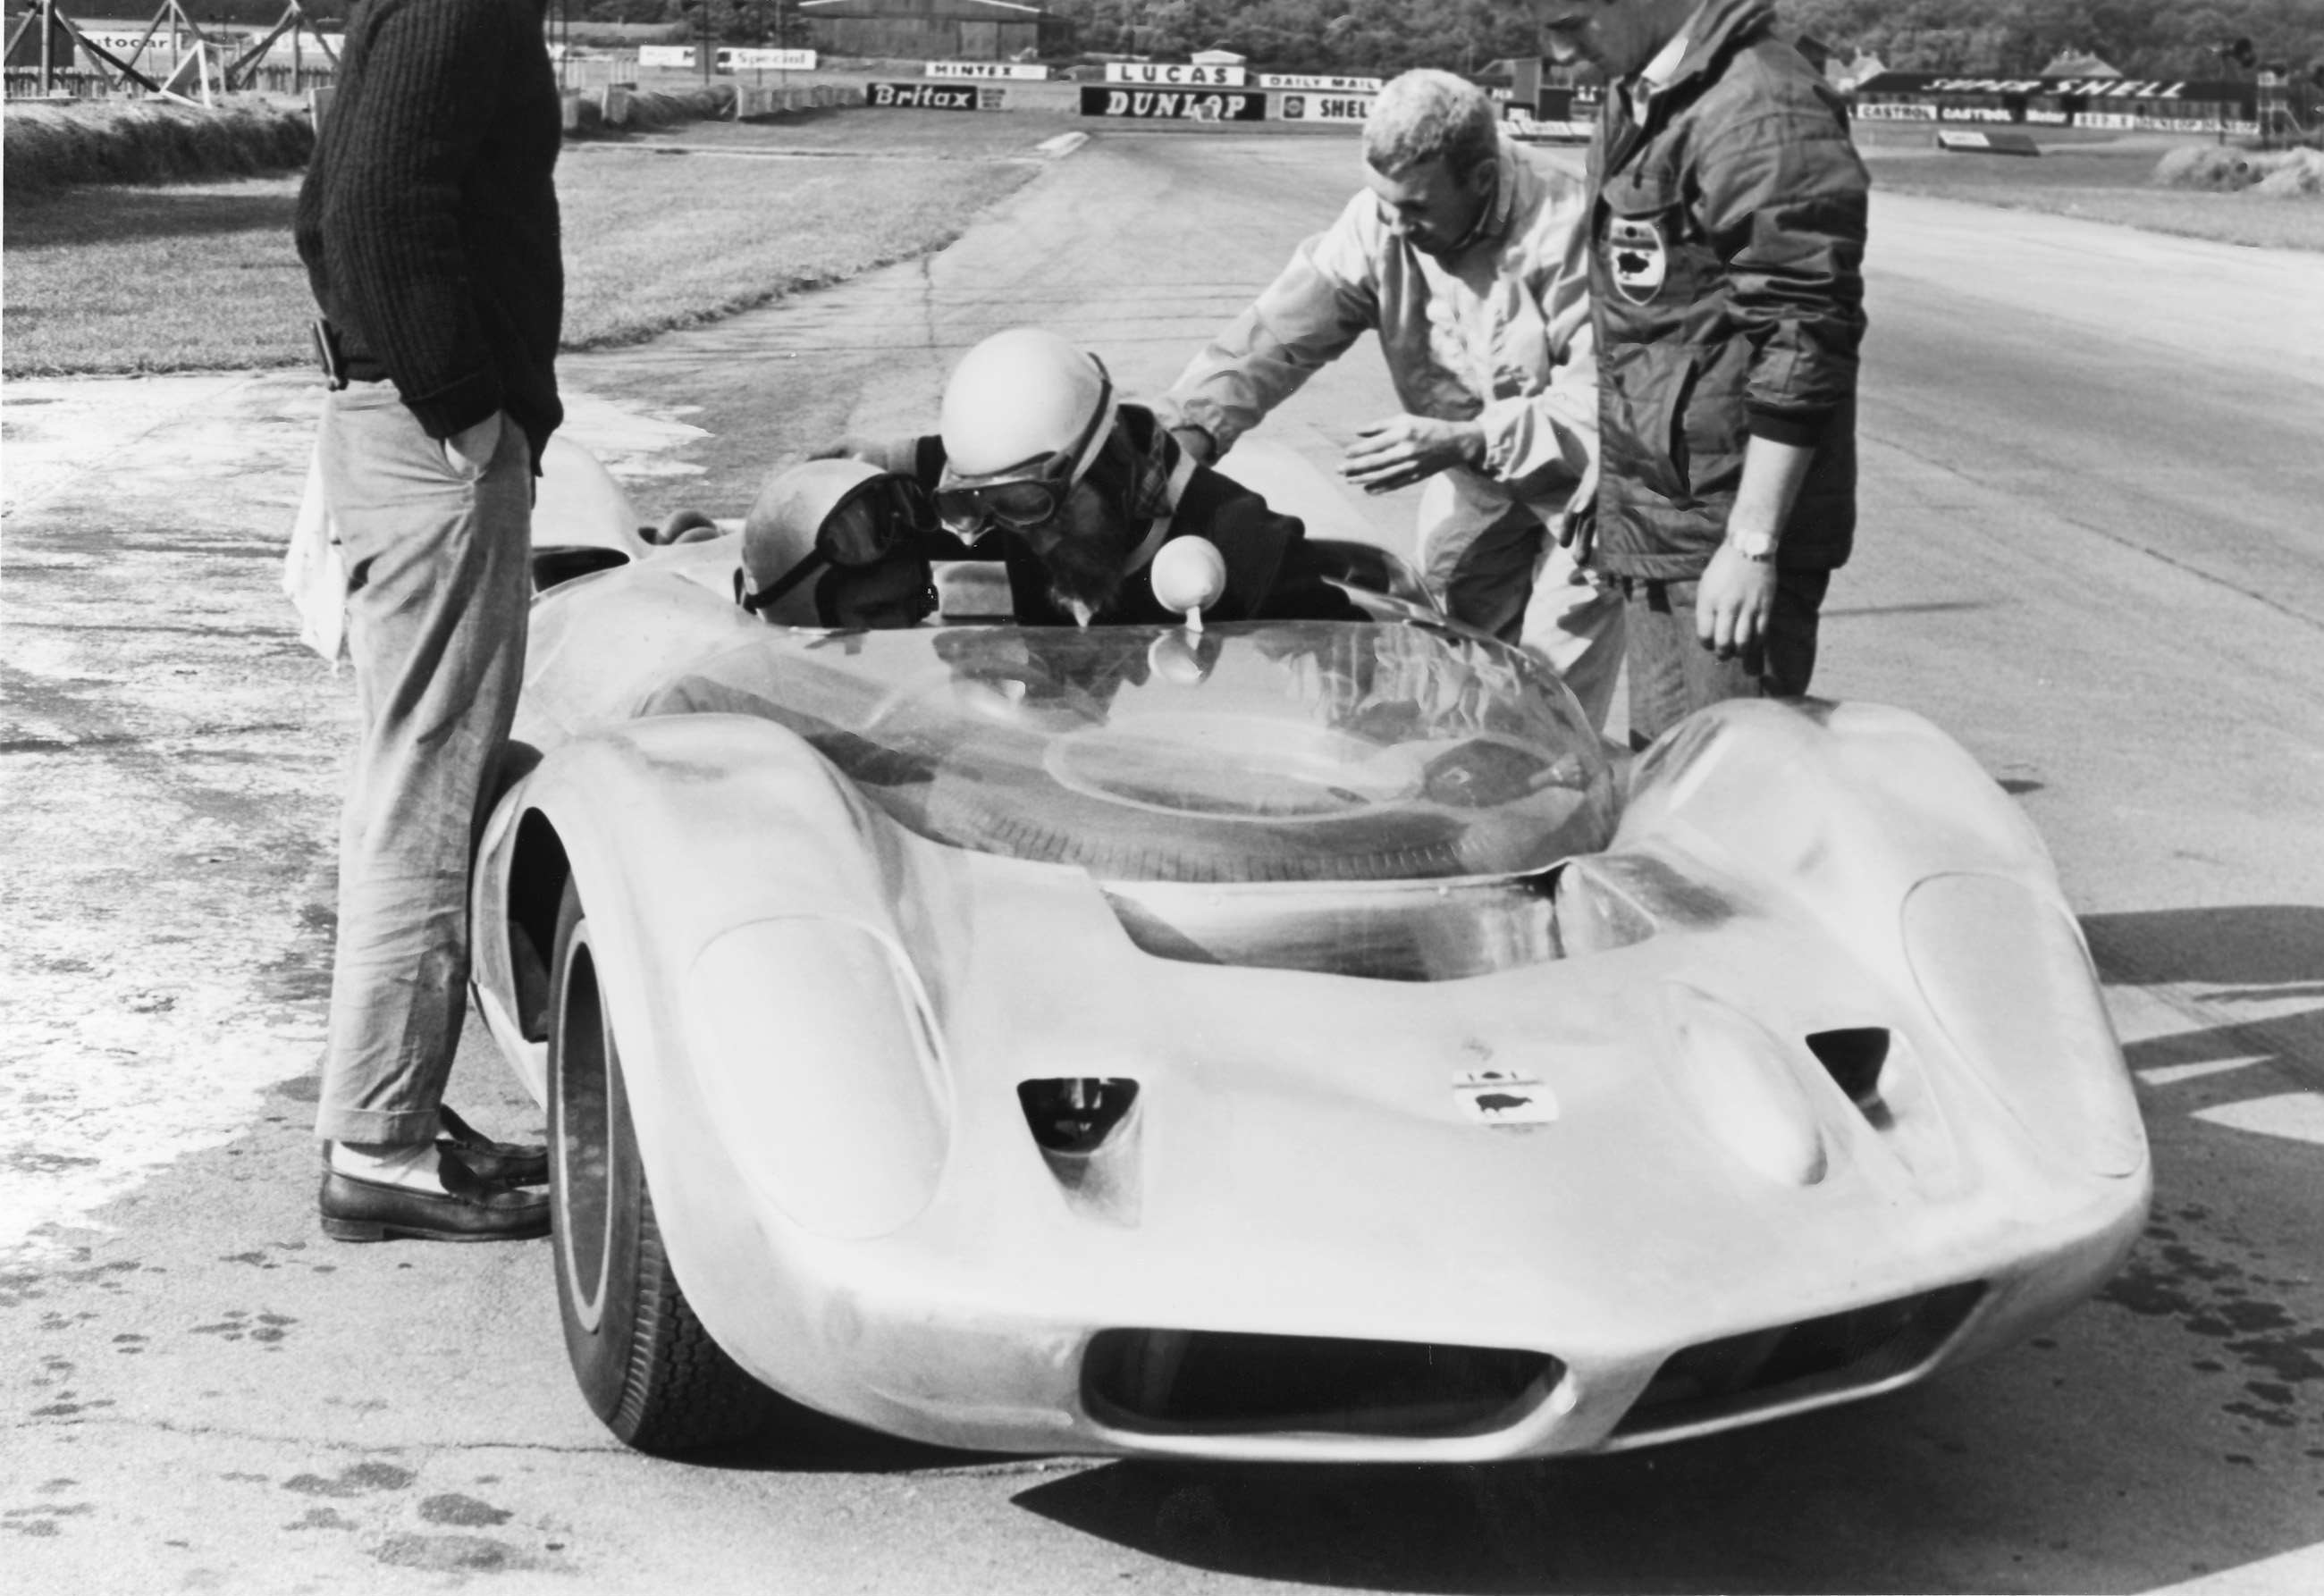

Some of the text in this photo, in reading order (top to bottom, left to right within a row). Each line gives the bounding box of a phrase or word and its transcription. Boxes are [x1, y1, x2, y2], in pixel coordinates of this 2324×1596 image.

[935, 65, 1012, 77] MINTEX
[1120, 65, 1227, 84] LUCAS
[1270, 77, 1375, 89] DAILY MAIL
[2043, 79, 2186, 98] SHELL
[875, 83, 973, 108] Britax
[1106, 90, 1247, 118] DUNLOP
[1320, 98, 1375, 119] SHEL
[1863, 105, 1932, 120] CASTROL
